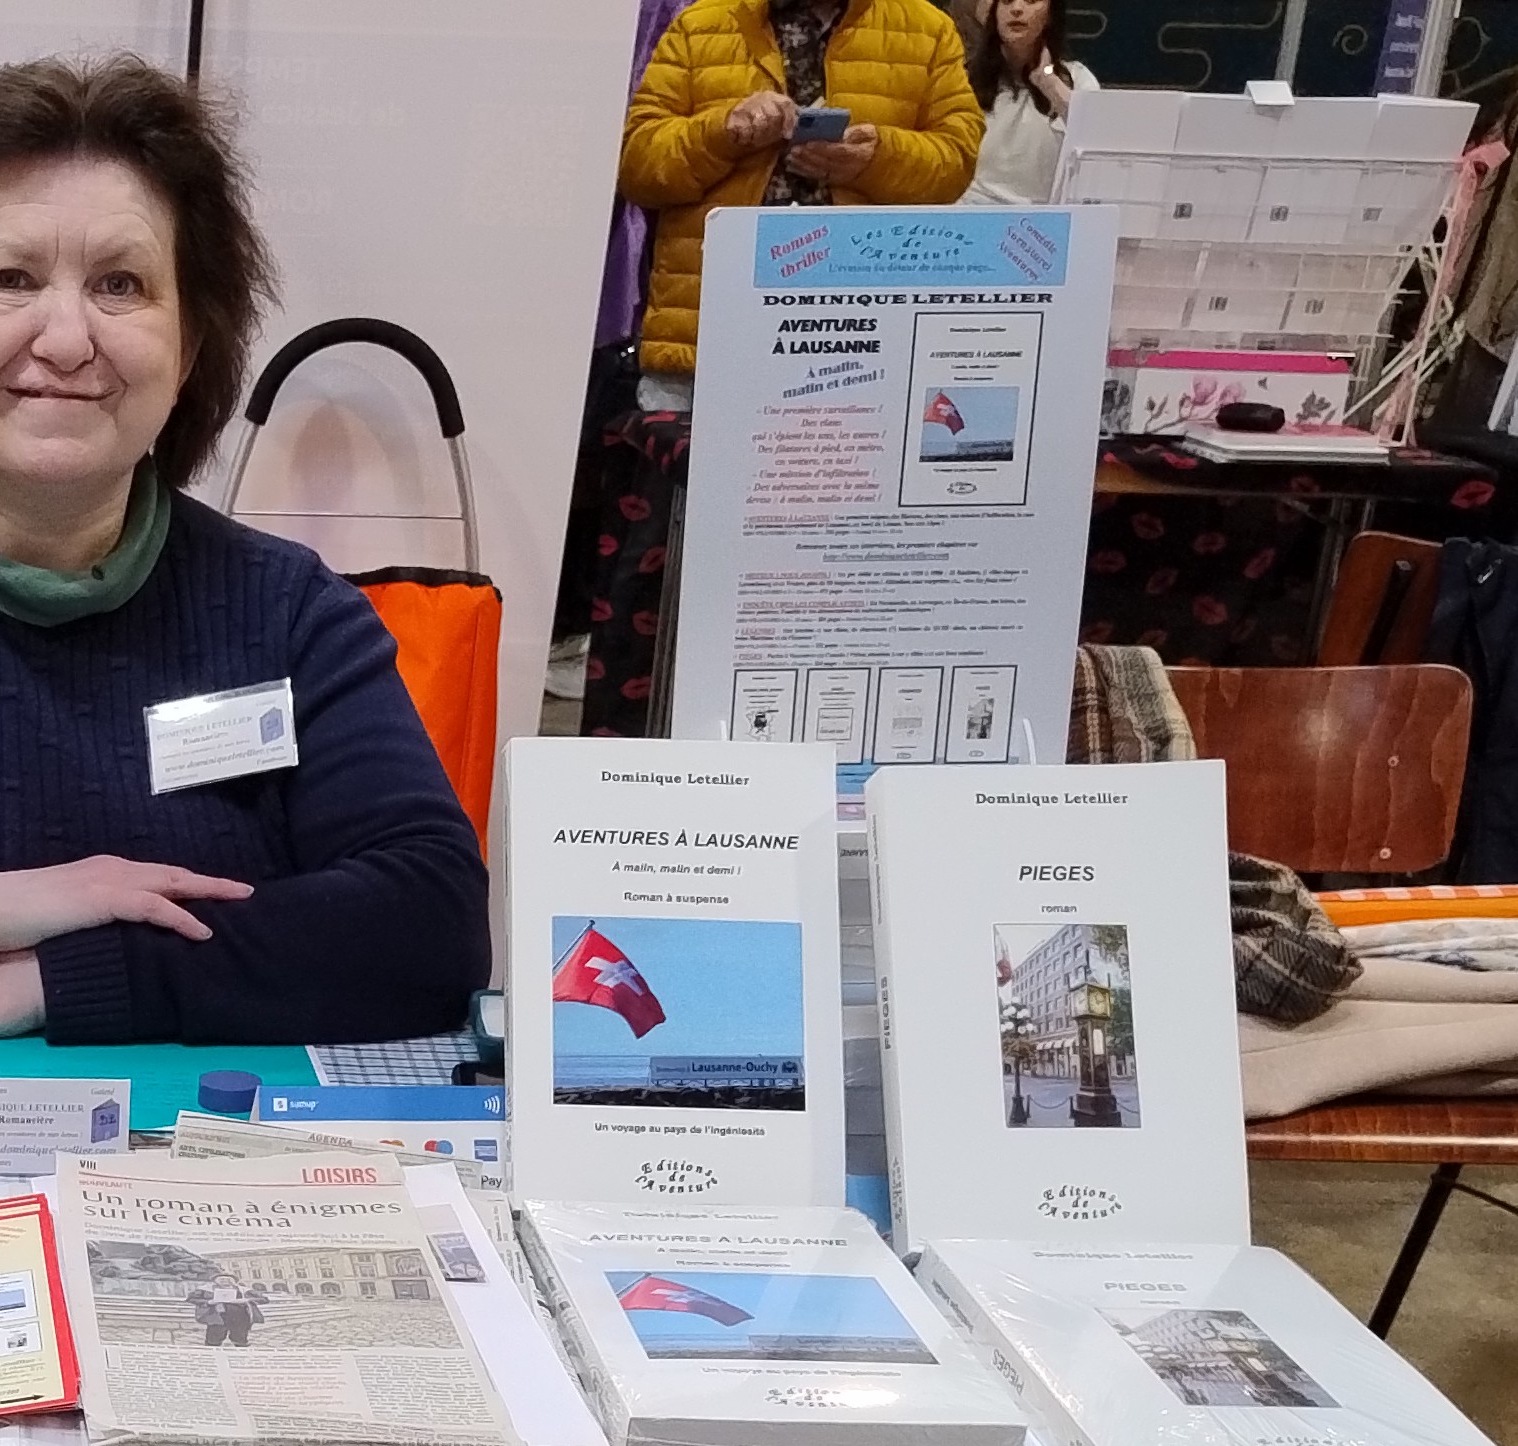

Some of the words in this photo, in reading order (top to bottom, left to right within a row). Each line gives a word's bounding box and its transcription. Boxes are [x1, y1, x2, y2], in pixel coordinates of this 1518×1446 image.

[769, 224, 829, 259] Romans
[763, 294, 906, 306] DOMINIQUE
[911, 293, 1052, 304] LETELLIER
[777, 318, 877, 332] AVENTURES
[771, 336, 785, 354] À
[789, 340, 880, 354] LAUSANNE
[601, 770, 681, 786] Dominique
[687, 773, 749, 785] Letellier
[975, 792, 1058, 806] Dominique
[1064, 792, 1128, 804] Letellier
[553, 829, 669, 845] AVENTURES
[674, 828, 687, 846] À
[694, 832, 799, 849] LAUSANNE
[1018, 865, 1094, 881] PIEGES
[1041, 905, 1077, 913] roman
[690, 1060, 780, 1076] Lausanne-Ouchy
[302, 1167, 377, 1184] LOISIRS
[82, 1190, 123, 1206] Un
[135, 1197, 233, 1213] roman
[245, 1198, 258, 1214] à
[271, 1201, 402, 1218] énigmes
[84, 1205, 130, 1221] sur
[143, 1208, 168, 1225] le
[178, 1213, 293, 1229] cinéma
[1103, 1282, 1187, 1291] PIEGES
